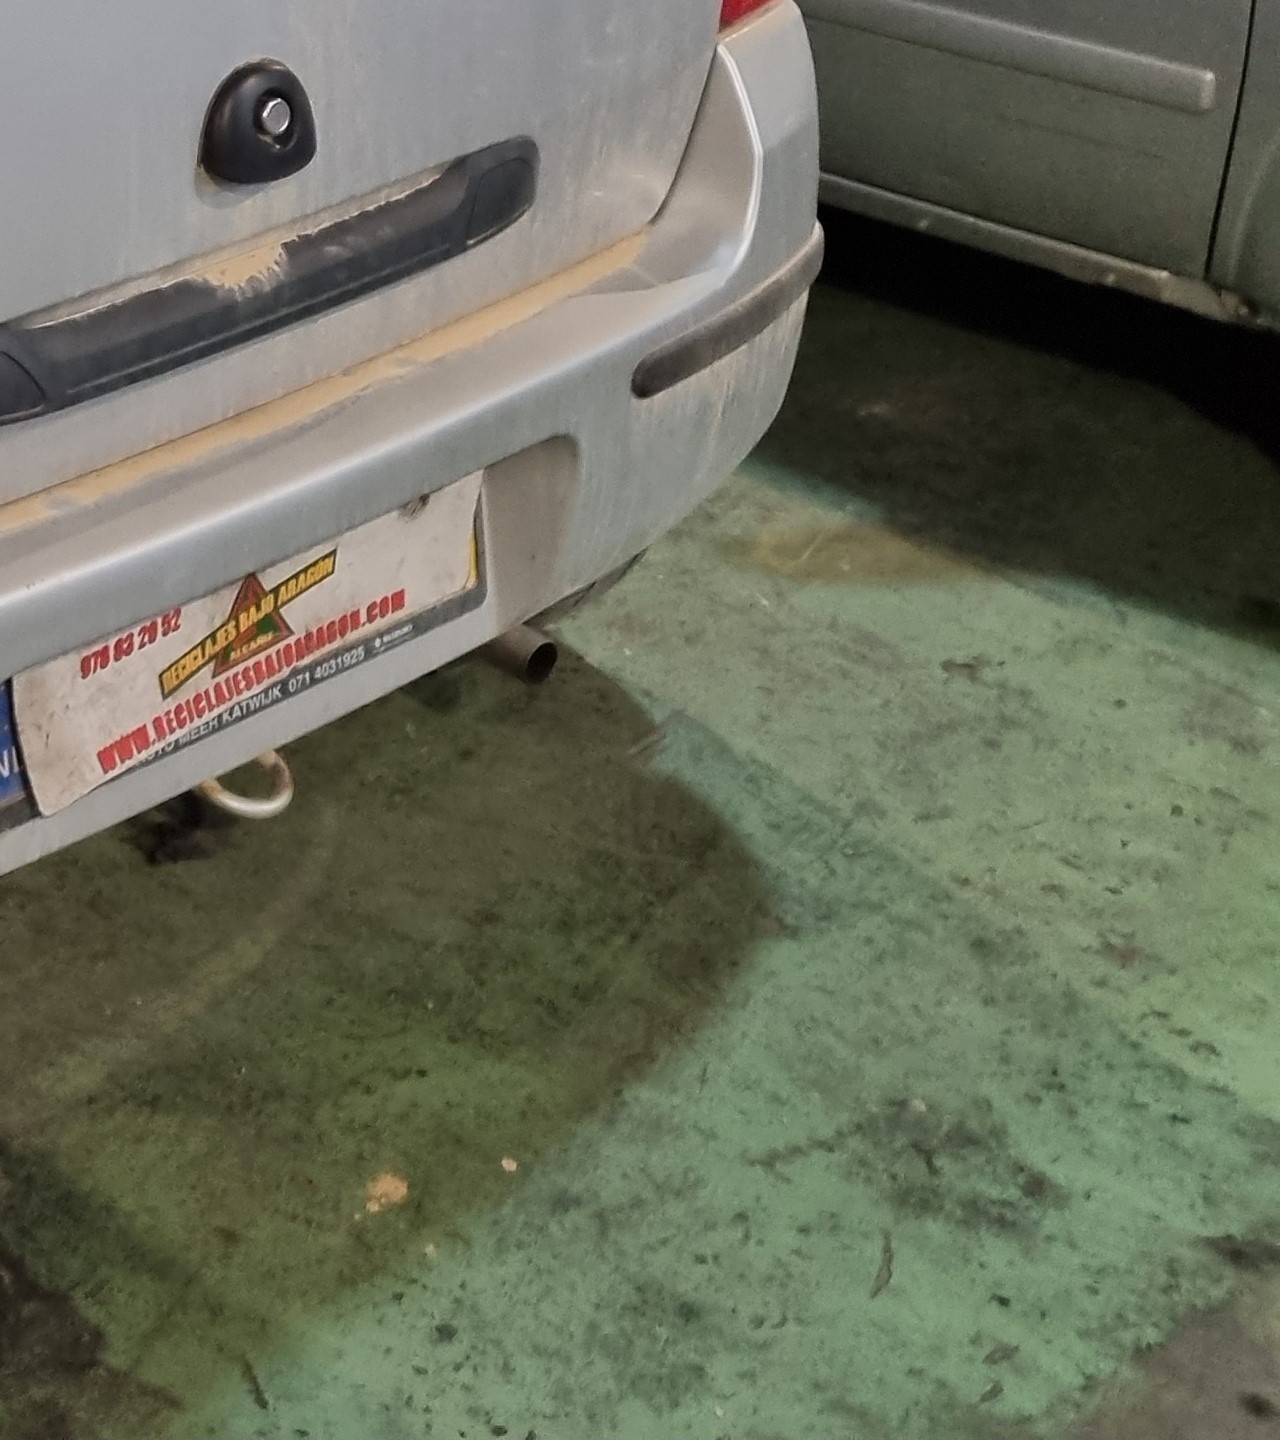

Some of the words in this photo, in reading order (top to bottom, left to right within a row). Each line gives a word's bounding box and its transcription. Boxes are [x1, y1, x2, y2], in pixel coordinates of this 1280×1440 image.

[137, 620, 159, 651] 20
[160, 607, 183, 638] 52
[222, 686, 283, 725] KATWIJK
[288, 669, 312, 694] 071
[313, 644, 366, 679] 4031925
